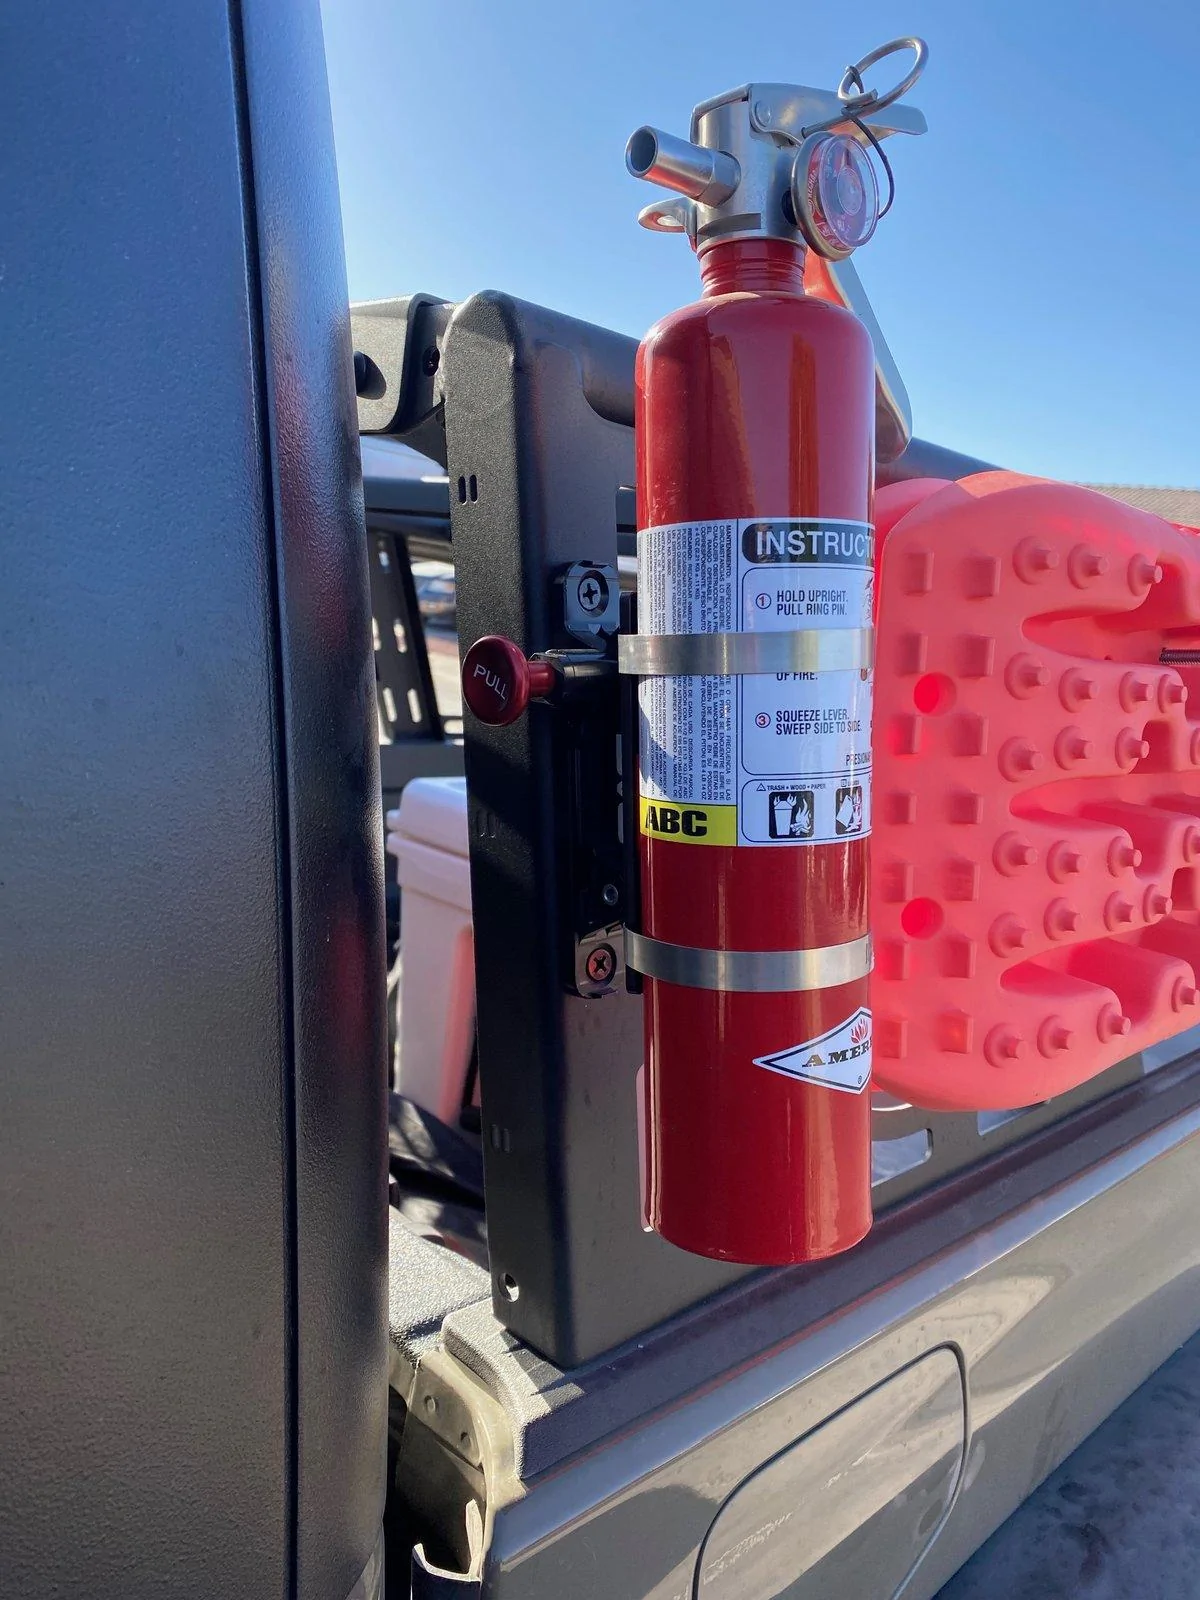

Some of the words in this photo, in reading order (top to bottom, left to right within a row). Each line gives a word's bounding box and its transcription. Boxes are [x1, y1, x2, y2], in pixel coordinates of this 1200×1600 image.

[777, 590, 804, 602] HOLD
[808, 590, 848, 602] UPRIGHT.
[777, 604, 803, 615] PULL
[806, 604, 829, 615] RING
[831, 604, 847, 615] PIN.
[473, 664, 506, 700] PULL
[776, 710, 820, 722] SQUEEZE
[823, 709, 849, 721] LEVER.
[776, 723, 811, 735] SWEEP
[813, 722, 834, 734] SIDE
[836, 721, 846, 733] TO
[646, 806, 707, 837] ABC
